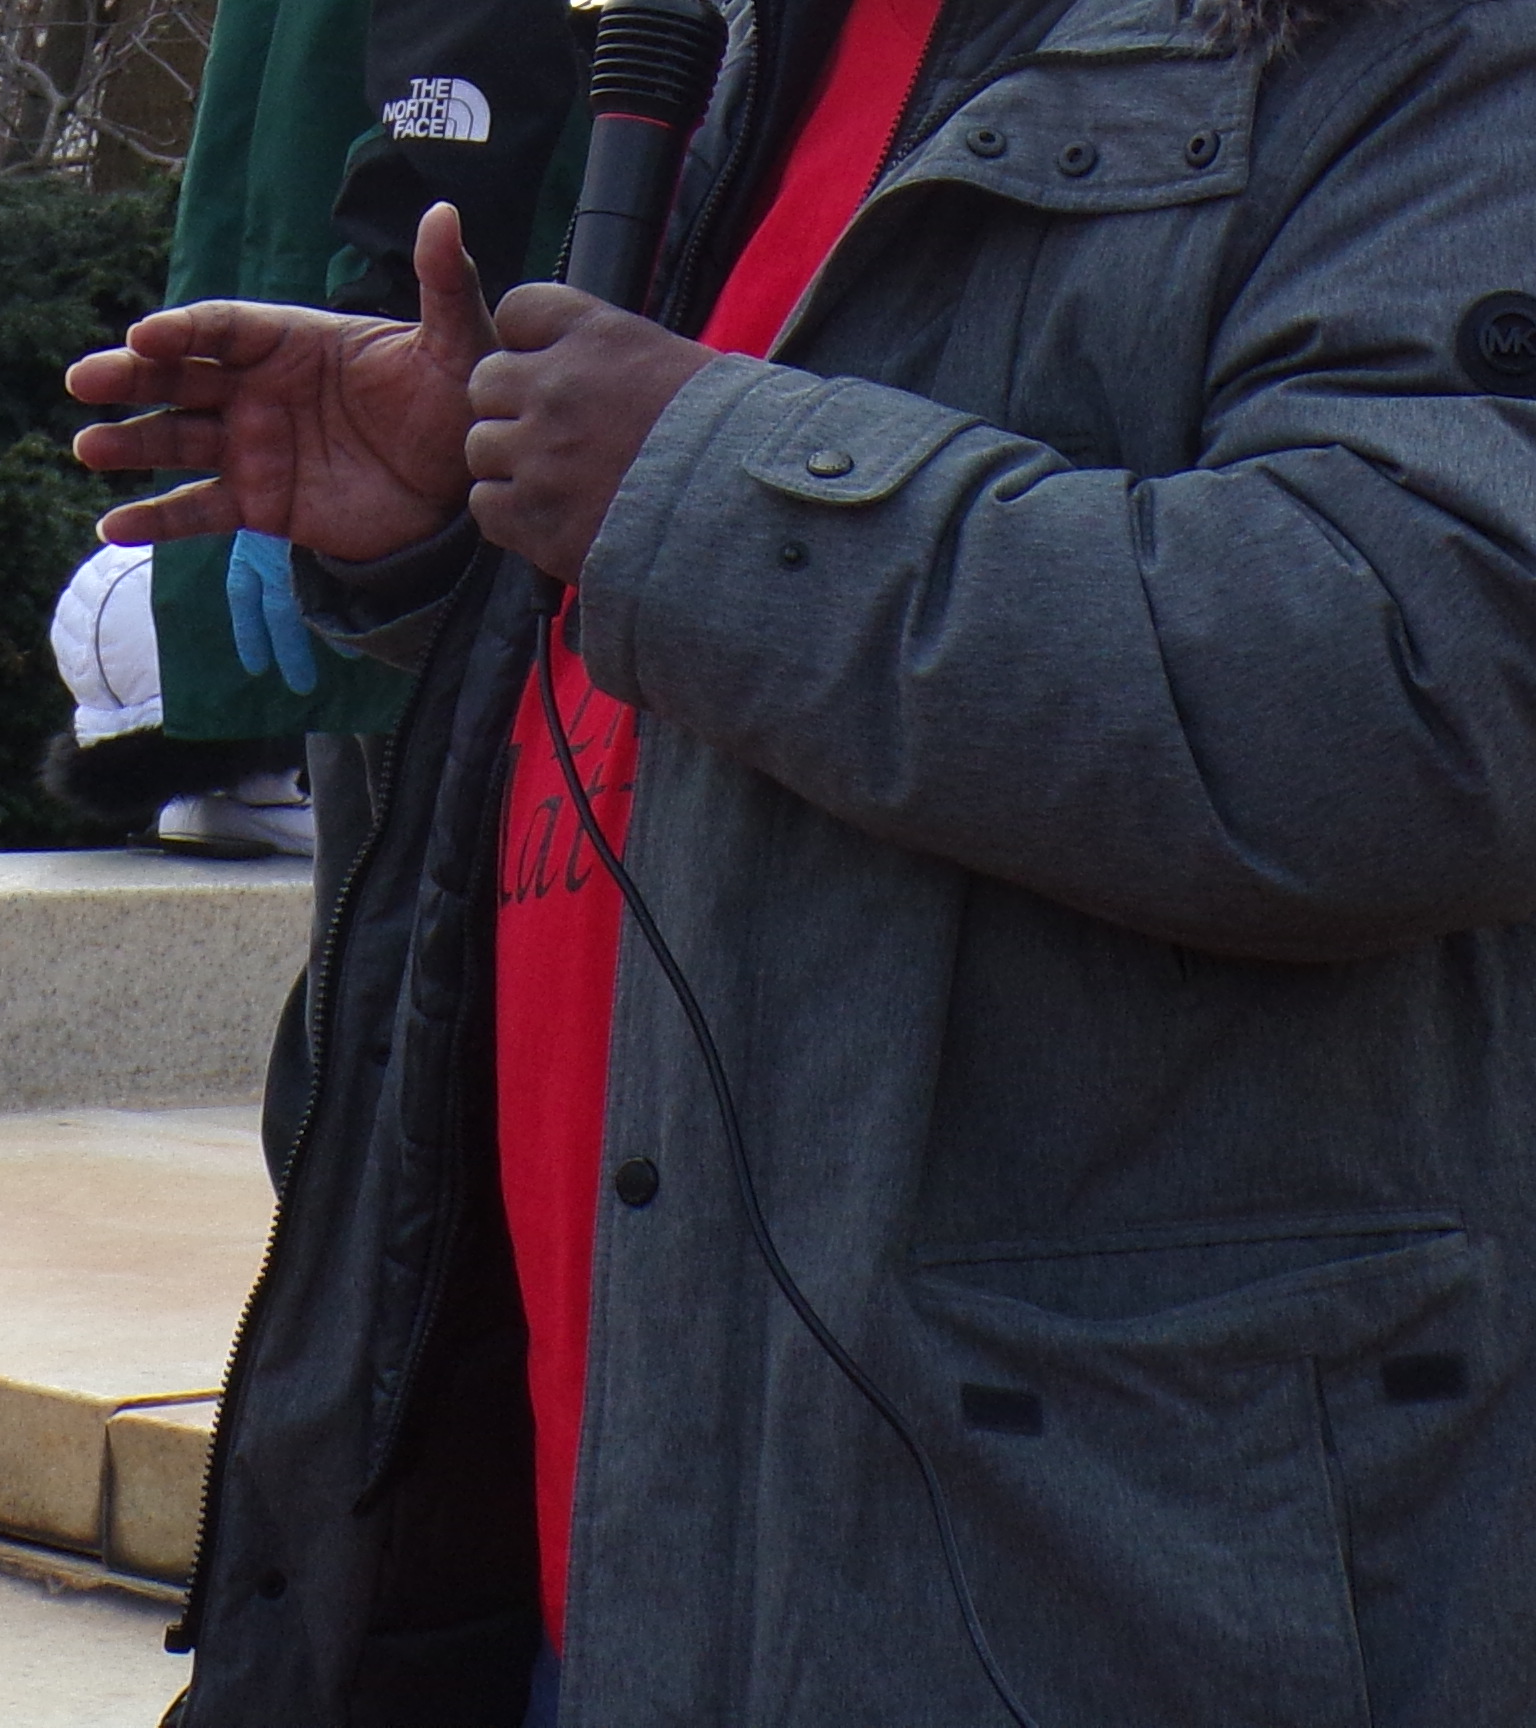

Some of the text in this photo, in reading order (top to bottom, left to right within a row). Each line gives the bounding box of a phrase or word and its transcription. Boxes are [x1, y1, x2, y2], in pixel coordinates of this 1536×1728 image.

[410, 78, 452, 99] THE
[382, 98, 449, 124] NORTH
[393, 118, 446, 142] FACE
